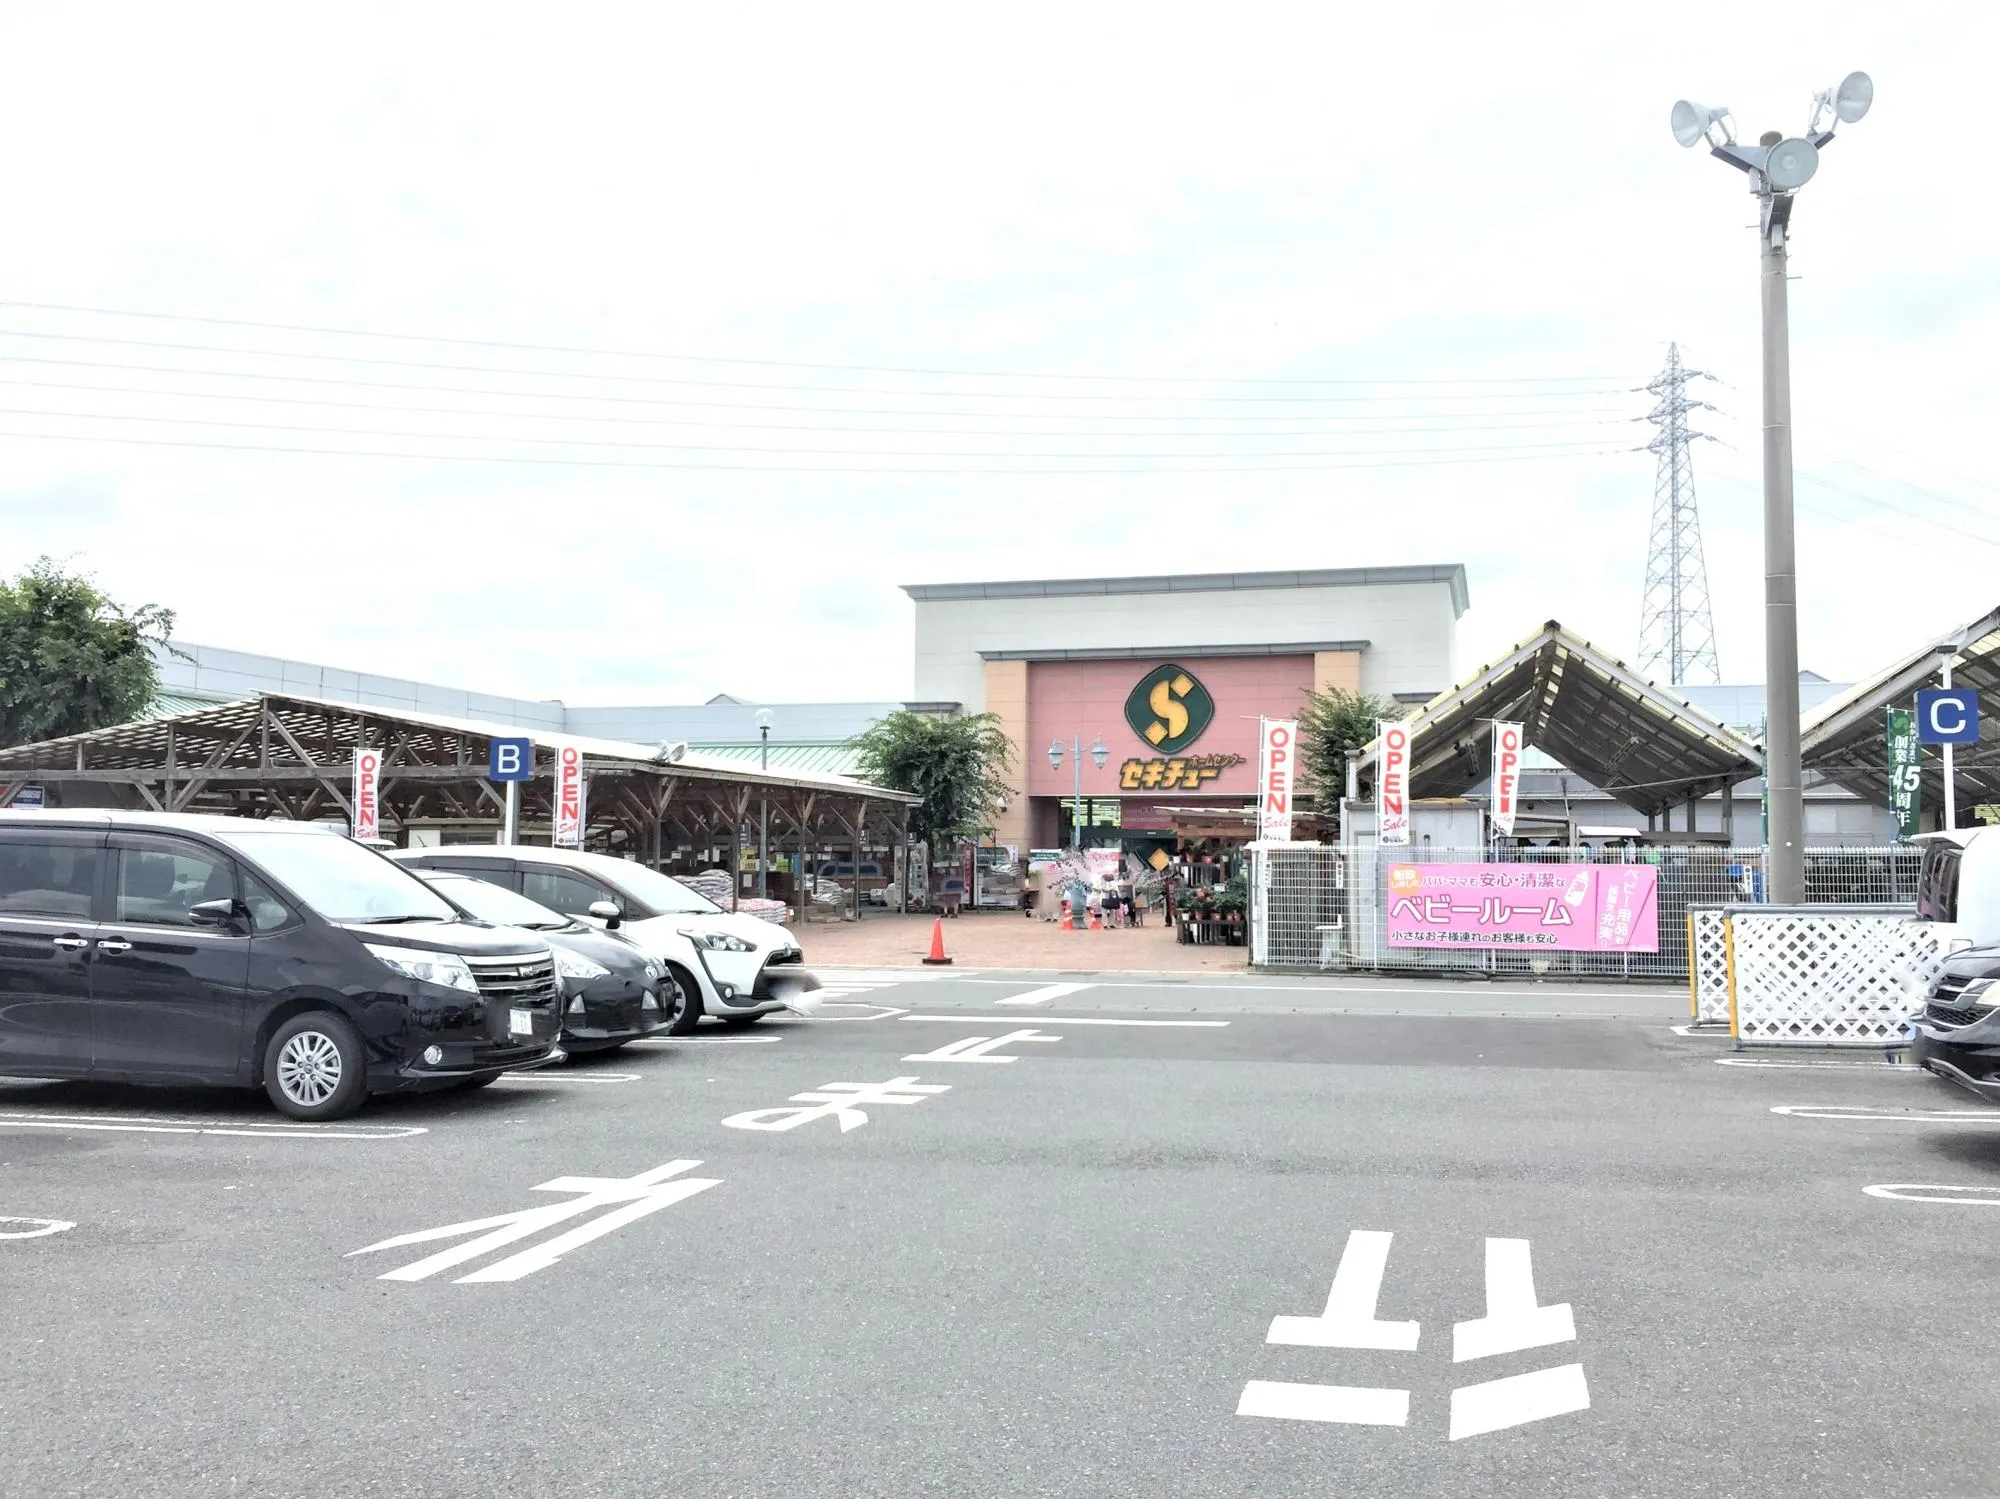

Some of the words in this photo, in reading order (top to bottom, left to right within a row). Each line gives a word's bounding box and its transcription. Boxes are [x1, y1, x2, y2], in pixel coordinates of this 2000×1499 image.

[1930, 697, 1967, 734] C
[497, 744, 521, 774] B
[1120, 758, 1219, 789] セキチュー
[1189, 753, 1247, 769] ホームセンター
[1266, 727, 1289, 814] OPEN
[1383, 729, 1406, 815] OPEN
[359, 754, 377, 826] OPEN
[561, 747, 579, 820] OPEN
[1892, 735, 1921, 827] 創業45周年
[356, 828, 378, 839] Sale
[558, 822, 578, 835] Sal
[1263, 816, 1290, 829] Sale
[1382, 818, 1408, 832] Sale
[1391, 893, 1573, 926] ベビールーム
[1391, 930, 1558, 945] 小さなお子様連れのお客様も安心
